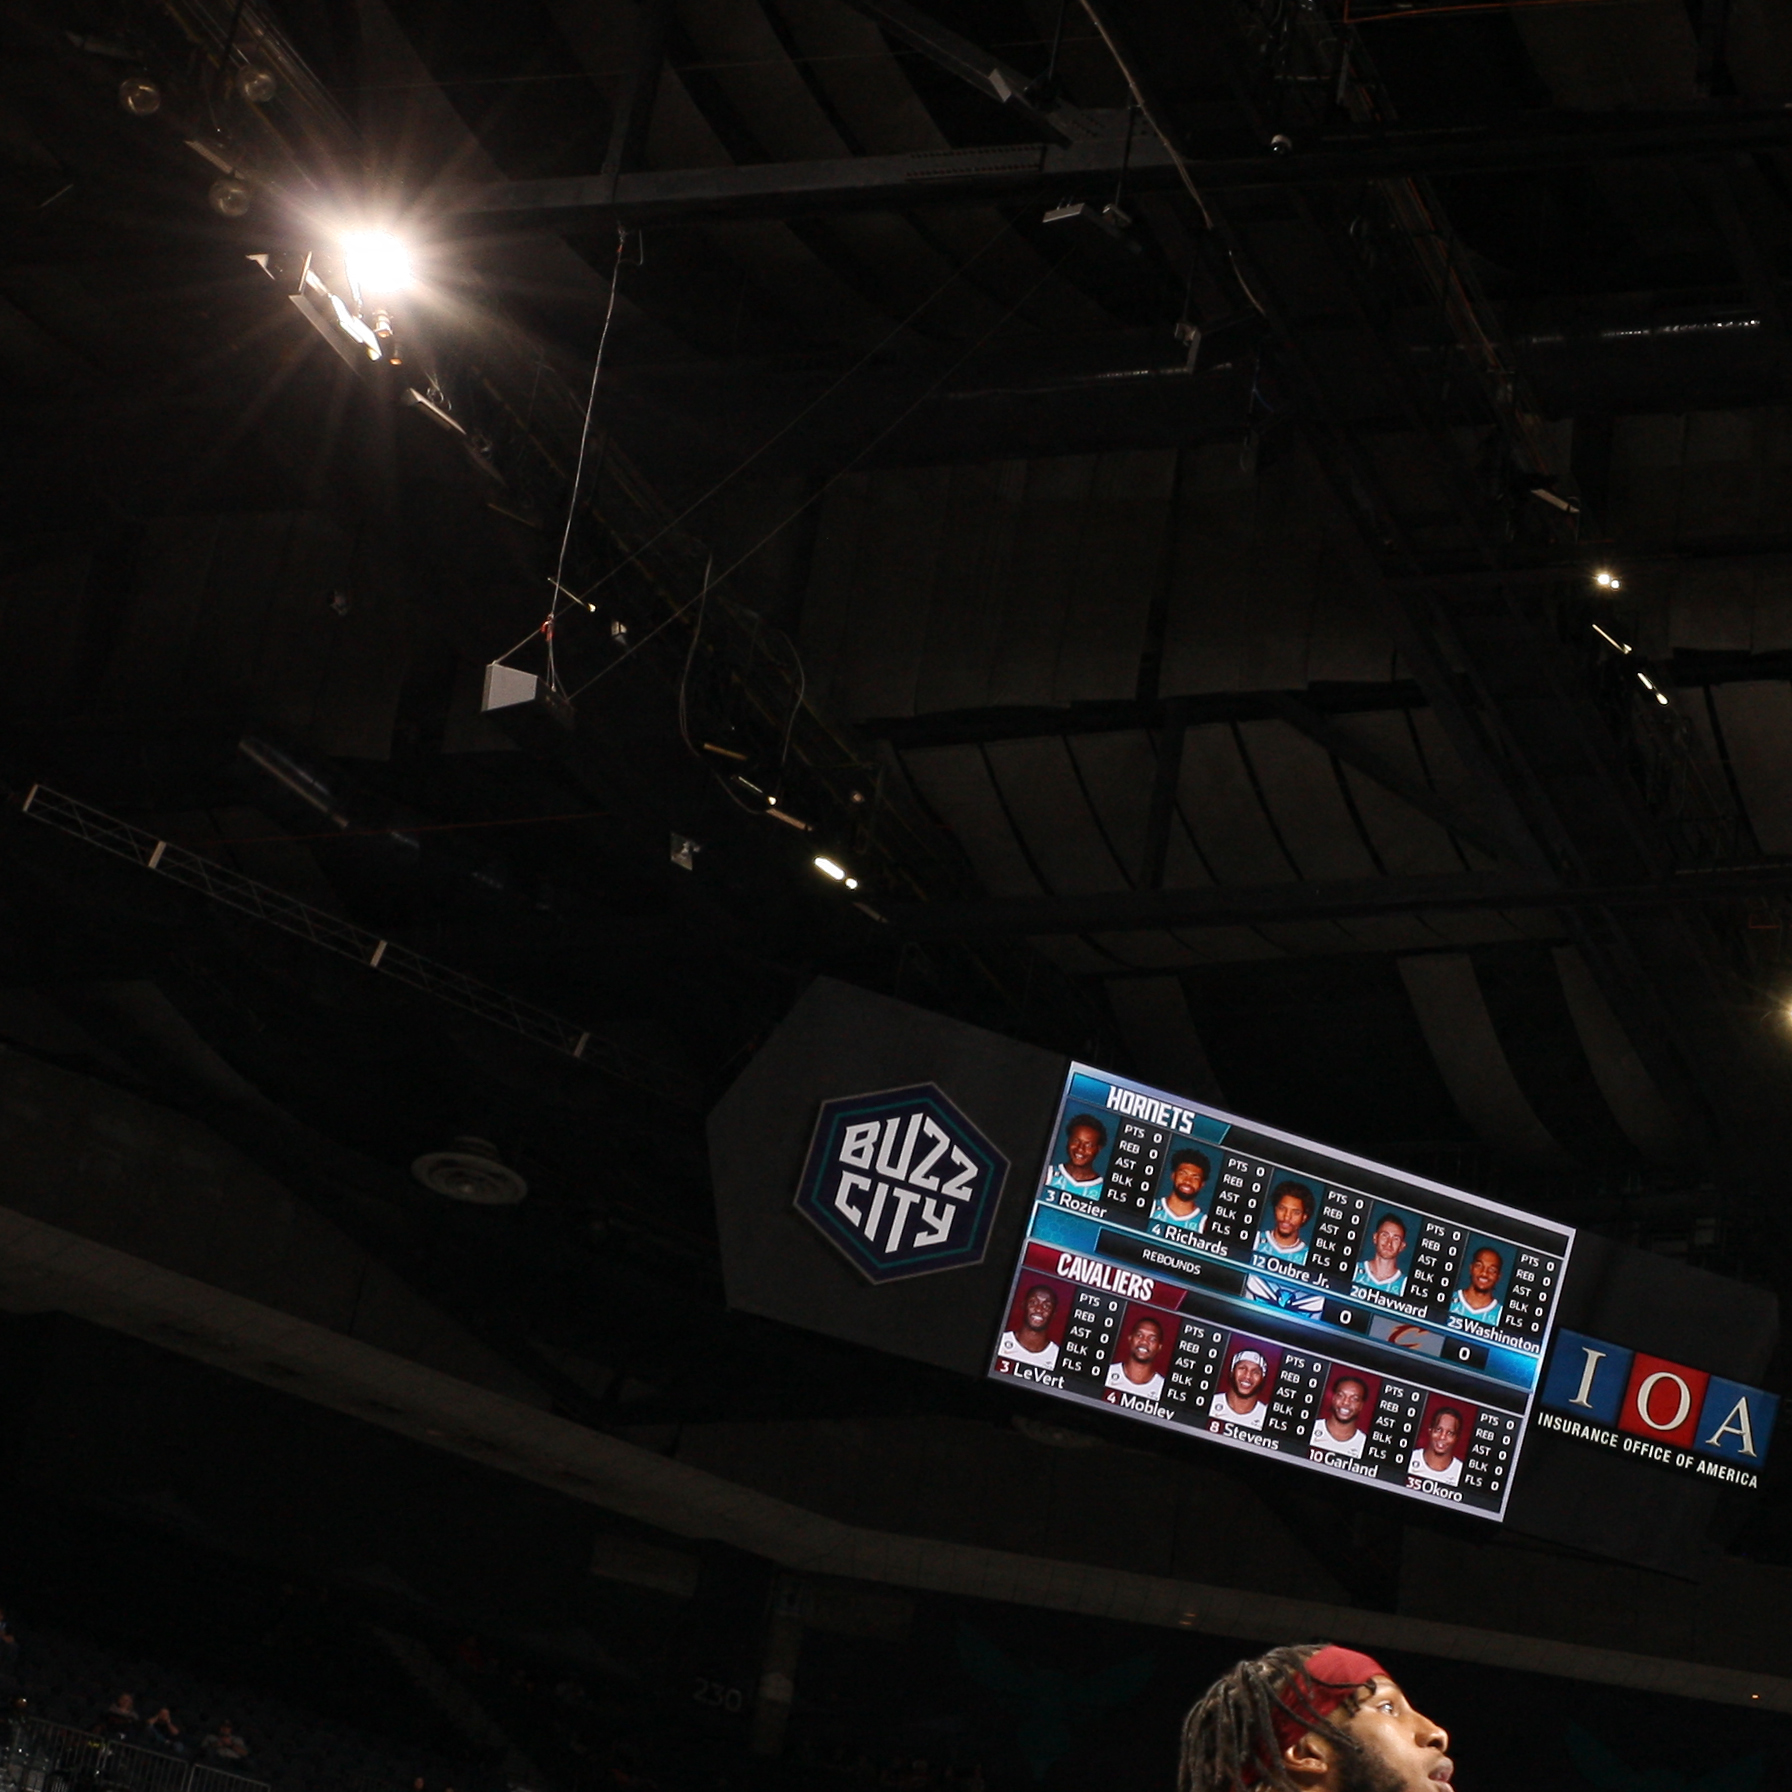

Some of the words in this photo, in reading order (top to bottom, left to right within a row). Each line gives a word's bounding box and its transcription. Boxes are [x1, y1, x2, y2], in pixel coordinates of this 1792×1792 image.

[1106, 1085, 1195, 1135] HORNETS
[838, 1112, 979, 1202] BUZZ
[834, 1169, 957, 1254] CITY
[1045, 1189, 1055, 1202] 3
[1058, 1192, 1108, 1219] Rozier
[1151, 1223, 1161, 1236] 4
[1164, 1225, 1229, 1257] Richards
[1142, 1249, 1202, 1275] REBOUNDS
[1252, 1254, 1265, 1269] 12
[1266, 1257, 1311, 1282] Oubre
[1313, 1272, 1330, 1290] Jr.
[1057, 1253, 1154, 1302] CAVALIERS
[1350, 1284, 1367, 1301] 20
[1339, 1310, 1352, 1325] 0
[1447, 1315, 1462, 1330] 25
[1458, 1347, 1471, 1361] 0
[1000, 1361, 1010, 1373] 3
[1013, 1362, 1065, 1389] LeVert
[1107, 1391, 1117, 1404] 4
[1209, 1421, 1220, 1434] 8
[1223, 1423, 1280, 1451] Stevens
[1537, 1411, 1619, 1448] INSURANCE
[1622, 1437, 1672, 1464] OFFICE
[1675, 1453, 1695, 1470] OF
[1696, 1460, 1758, 1489] AMERICA
[1309, 1448, 1323, 1462] 10
[1324, 1451, 1378, 1479] Garland
[1406, 1476, 1422, 1490] 35
[1422, 1480, 1463, 1502] Okoro
